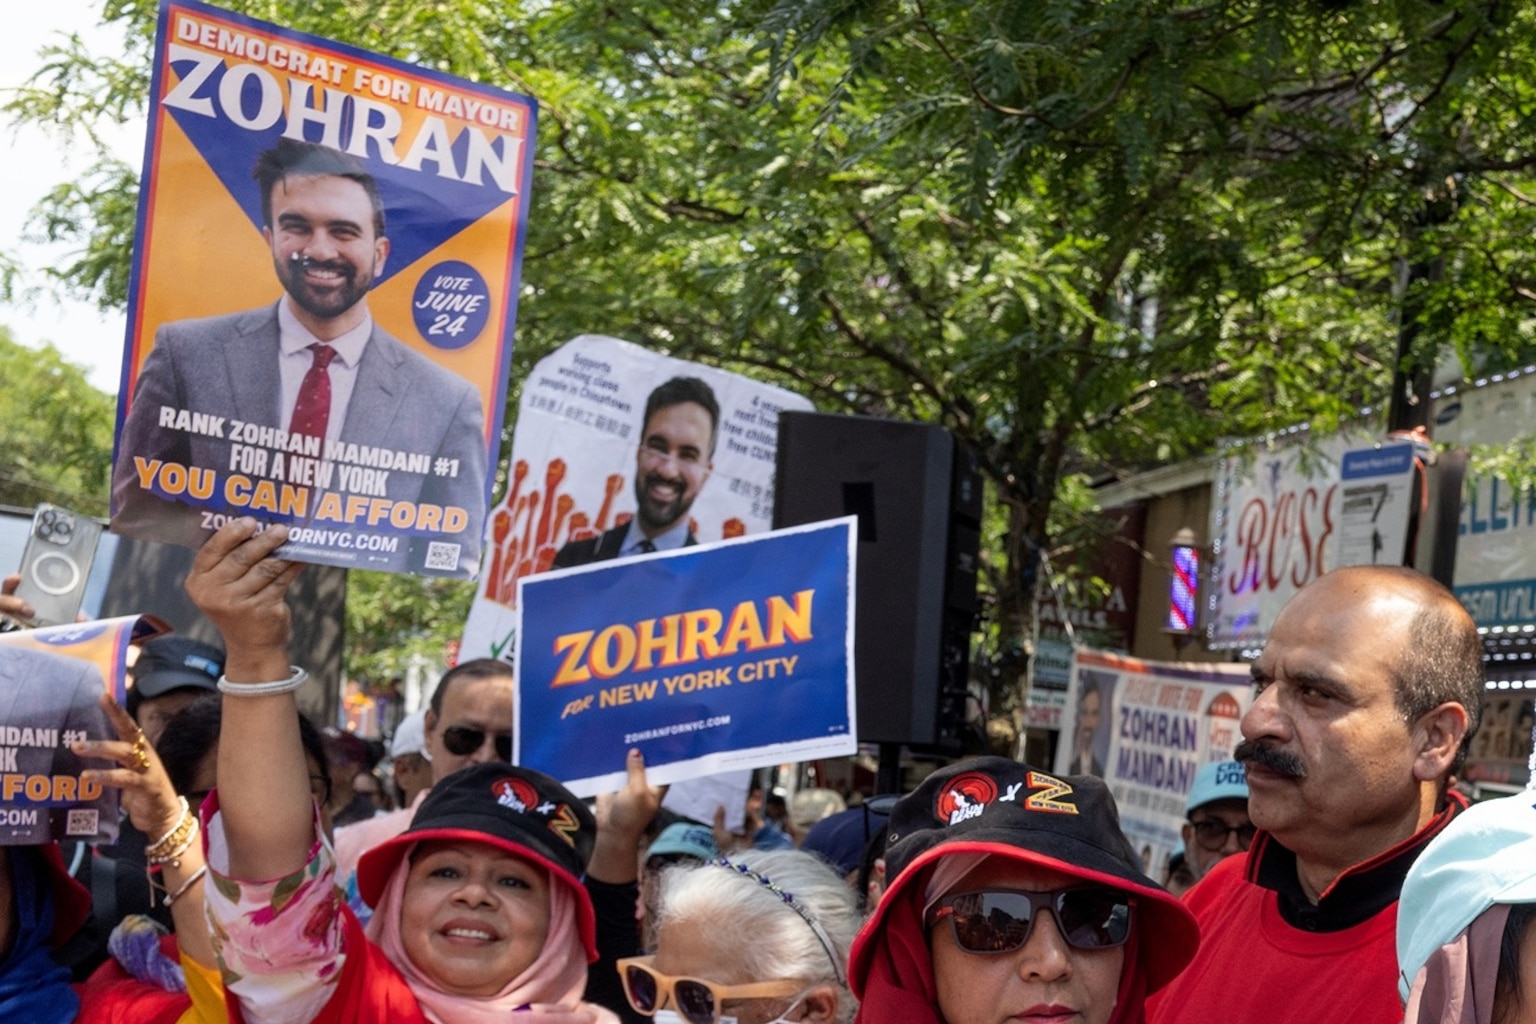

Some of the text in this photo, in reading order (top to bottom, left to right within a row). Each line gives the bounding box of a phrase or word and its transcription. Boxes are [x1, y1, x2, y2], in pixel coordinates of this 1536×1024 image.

[178, 18, 518, 131] DEMOCRAT FOR MAYOR
[162, 43, 524, 194] ZOHRAN
[415, 291, 485, 313] JUNE
[433, 275, 472, 291] VOTE
[429, 315, 465, 336] 24
[580, 386, 632, 413] Chinatown
[159, 406, 459, 478] RANK ZOHRAN MAMDANI #1
[229, 445, 390, 497] FOR A NEW YORK
[134, 456, 469, 534] YOU CAN AFFORD
[200, 512, 398, 552] ZOAORNYC.COM
[550, 589, 815, 689] ZOHRAN
[599, 680, 657, 709] NEW
[663, 667, 732, 697] YORK
[737, 655, 798, 683] CITY
[0, 726, 58, 748] DANI
[624, 715, 731, 744] ZOHRANFORNYC.COM
[1121, 706, 1196, 752] ZOHRAN
[0, 775, 103, 802] FORD
[1115, 747, 1196, 796] MAMDANI
